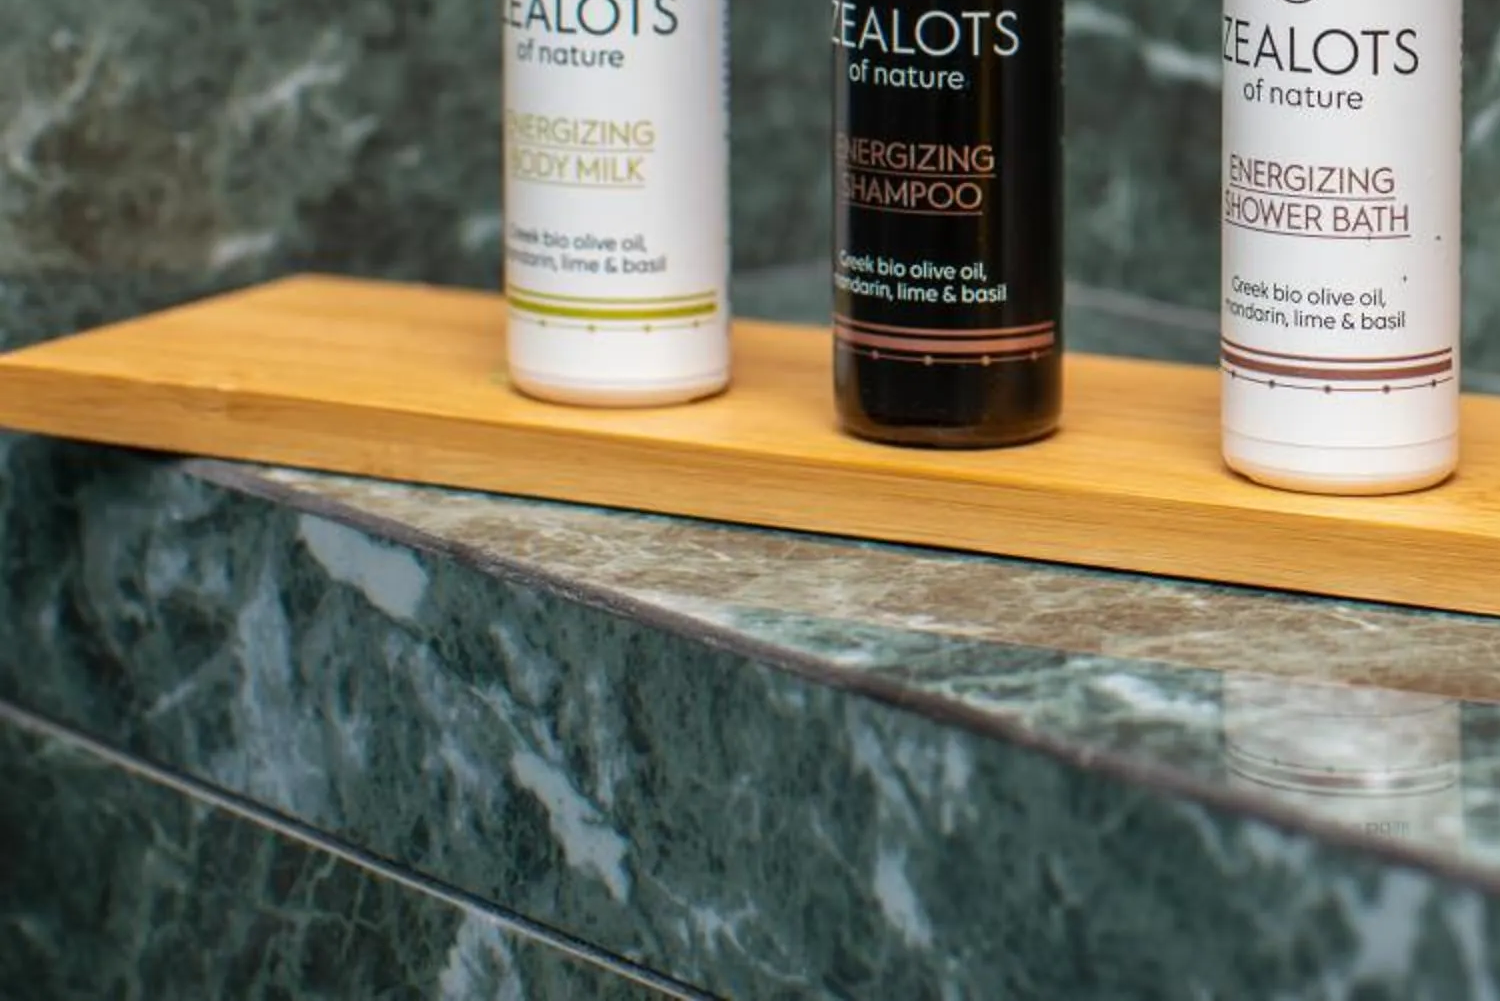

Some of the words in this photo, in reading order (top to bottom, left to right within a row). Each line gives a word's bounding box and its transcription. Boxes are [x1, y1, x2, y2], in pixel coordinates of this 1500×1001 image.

[832, 0, 1019, 57] ZEALOTS
[517, 38, 535, 61] of
[538, 44, 625, 68] nature
[1223, 16, 1419, 75] ZEALOTS
[849, 59, 869, 83] of
[874, 66, 964, 90] nature
[1244, 78, 1264, 103] of
[1269, 85, 1363, 110] nature
[576, 155, 645, 182] MILK
[1230, 154, 1395, 194] ENERGIZING
[1225, 190, 1323, 231] SHOWER
[1334, 204, 1409, 232] BATH
[544, 230, 569, 248] bio
[574, 232, 617, 251] olive
[561, 254, 599, 273] lime
[605, 256, 618, 273] &
[623, 255, 667, 273] basil
[877, 256, 906, 278] bio
[910, 260, 956, 280] olive
[961, 262, 987, 282] oil,
[897, 282, 938, 302] lime
[942, 285, 957, 303] &
[962, 284, 1007, 303] basil
[1232, 276, 1269, 298] Greek
[1273, 283, 1303, 304] bio
[1307, 288, 1354, 307] olive
[1359, 288, 1387, 308] oil,
[1294, 310, 1336, 330] lime
[1342, 312, 1354, 330] &
[1361, 311, 1406, 331] basil
